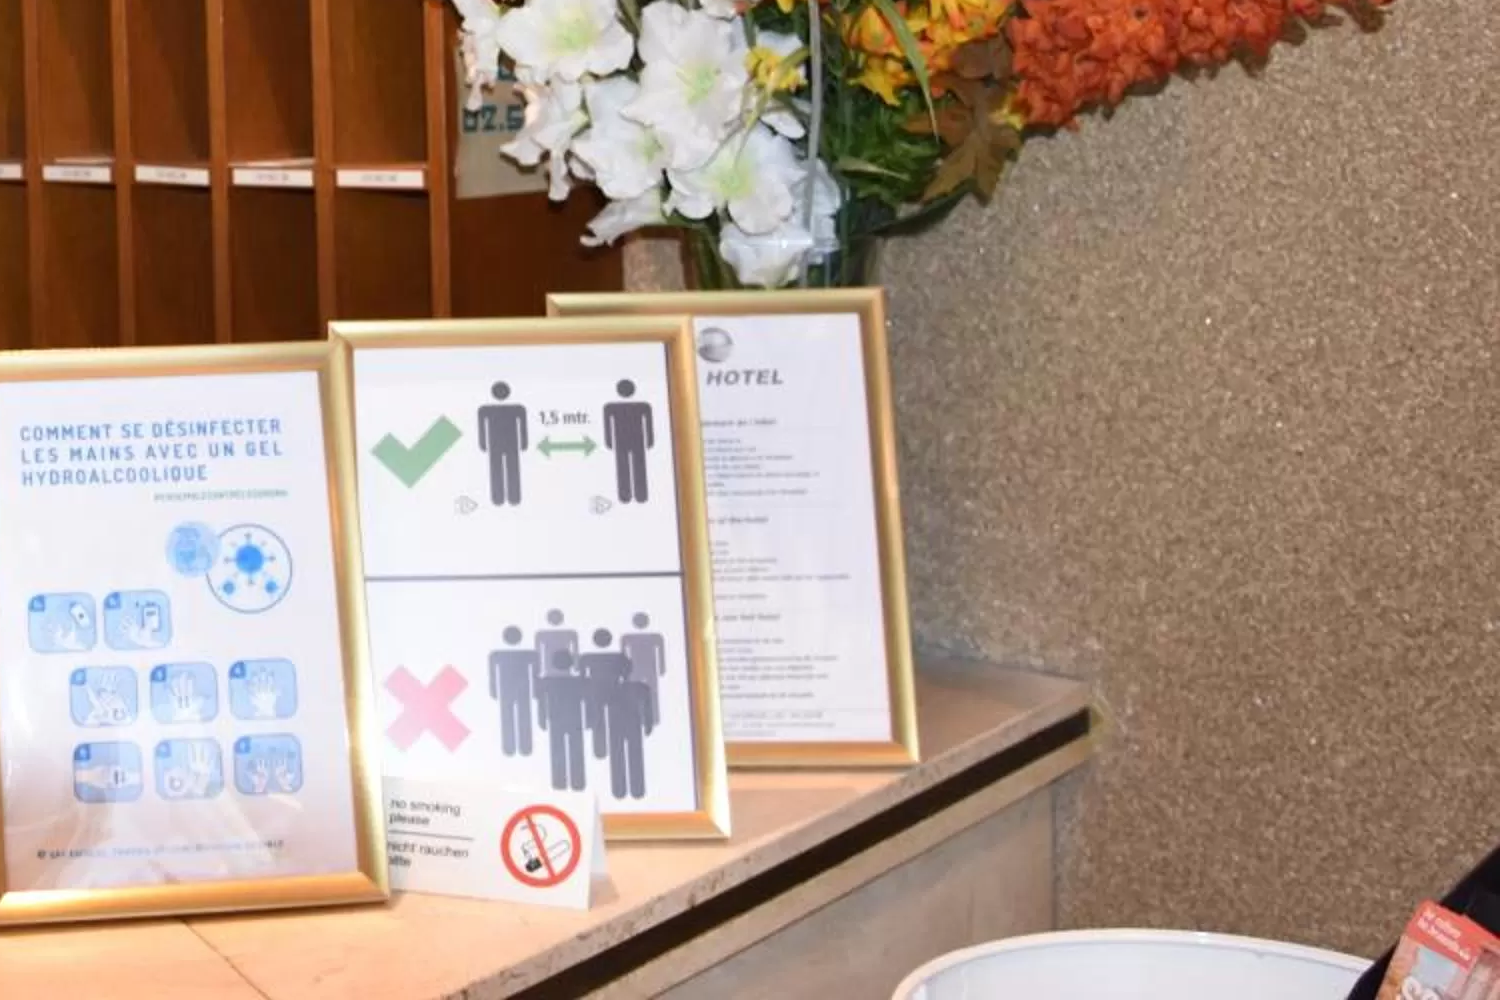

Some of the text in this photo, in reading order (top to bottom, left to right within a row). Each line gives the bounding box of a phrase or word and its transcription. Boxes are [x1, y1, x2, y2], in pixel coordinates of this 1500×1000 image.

[706, 369, 784, 386] HOTEL
[562, 410, 592, 426] mtr.
[20, 418, 282, 442] COMMENT SE DÉSINFECTER
[20, 440, 283, 465] LES MAINS AVEC UN GEL
[21, 464, 209, 487] HYDROALCOOLIQUE
[410, 801, 461, 817] smoking
[389, 813, 430, 826] please
[419, 845, 470, 858] rauchen
